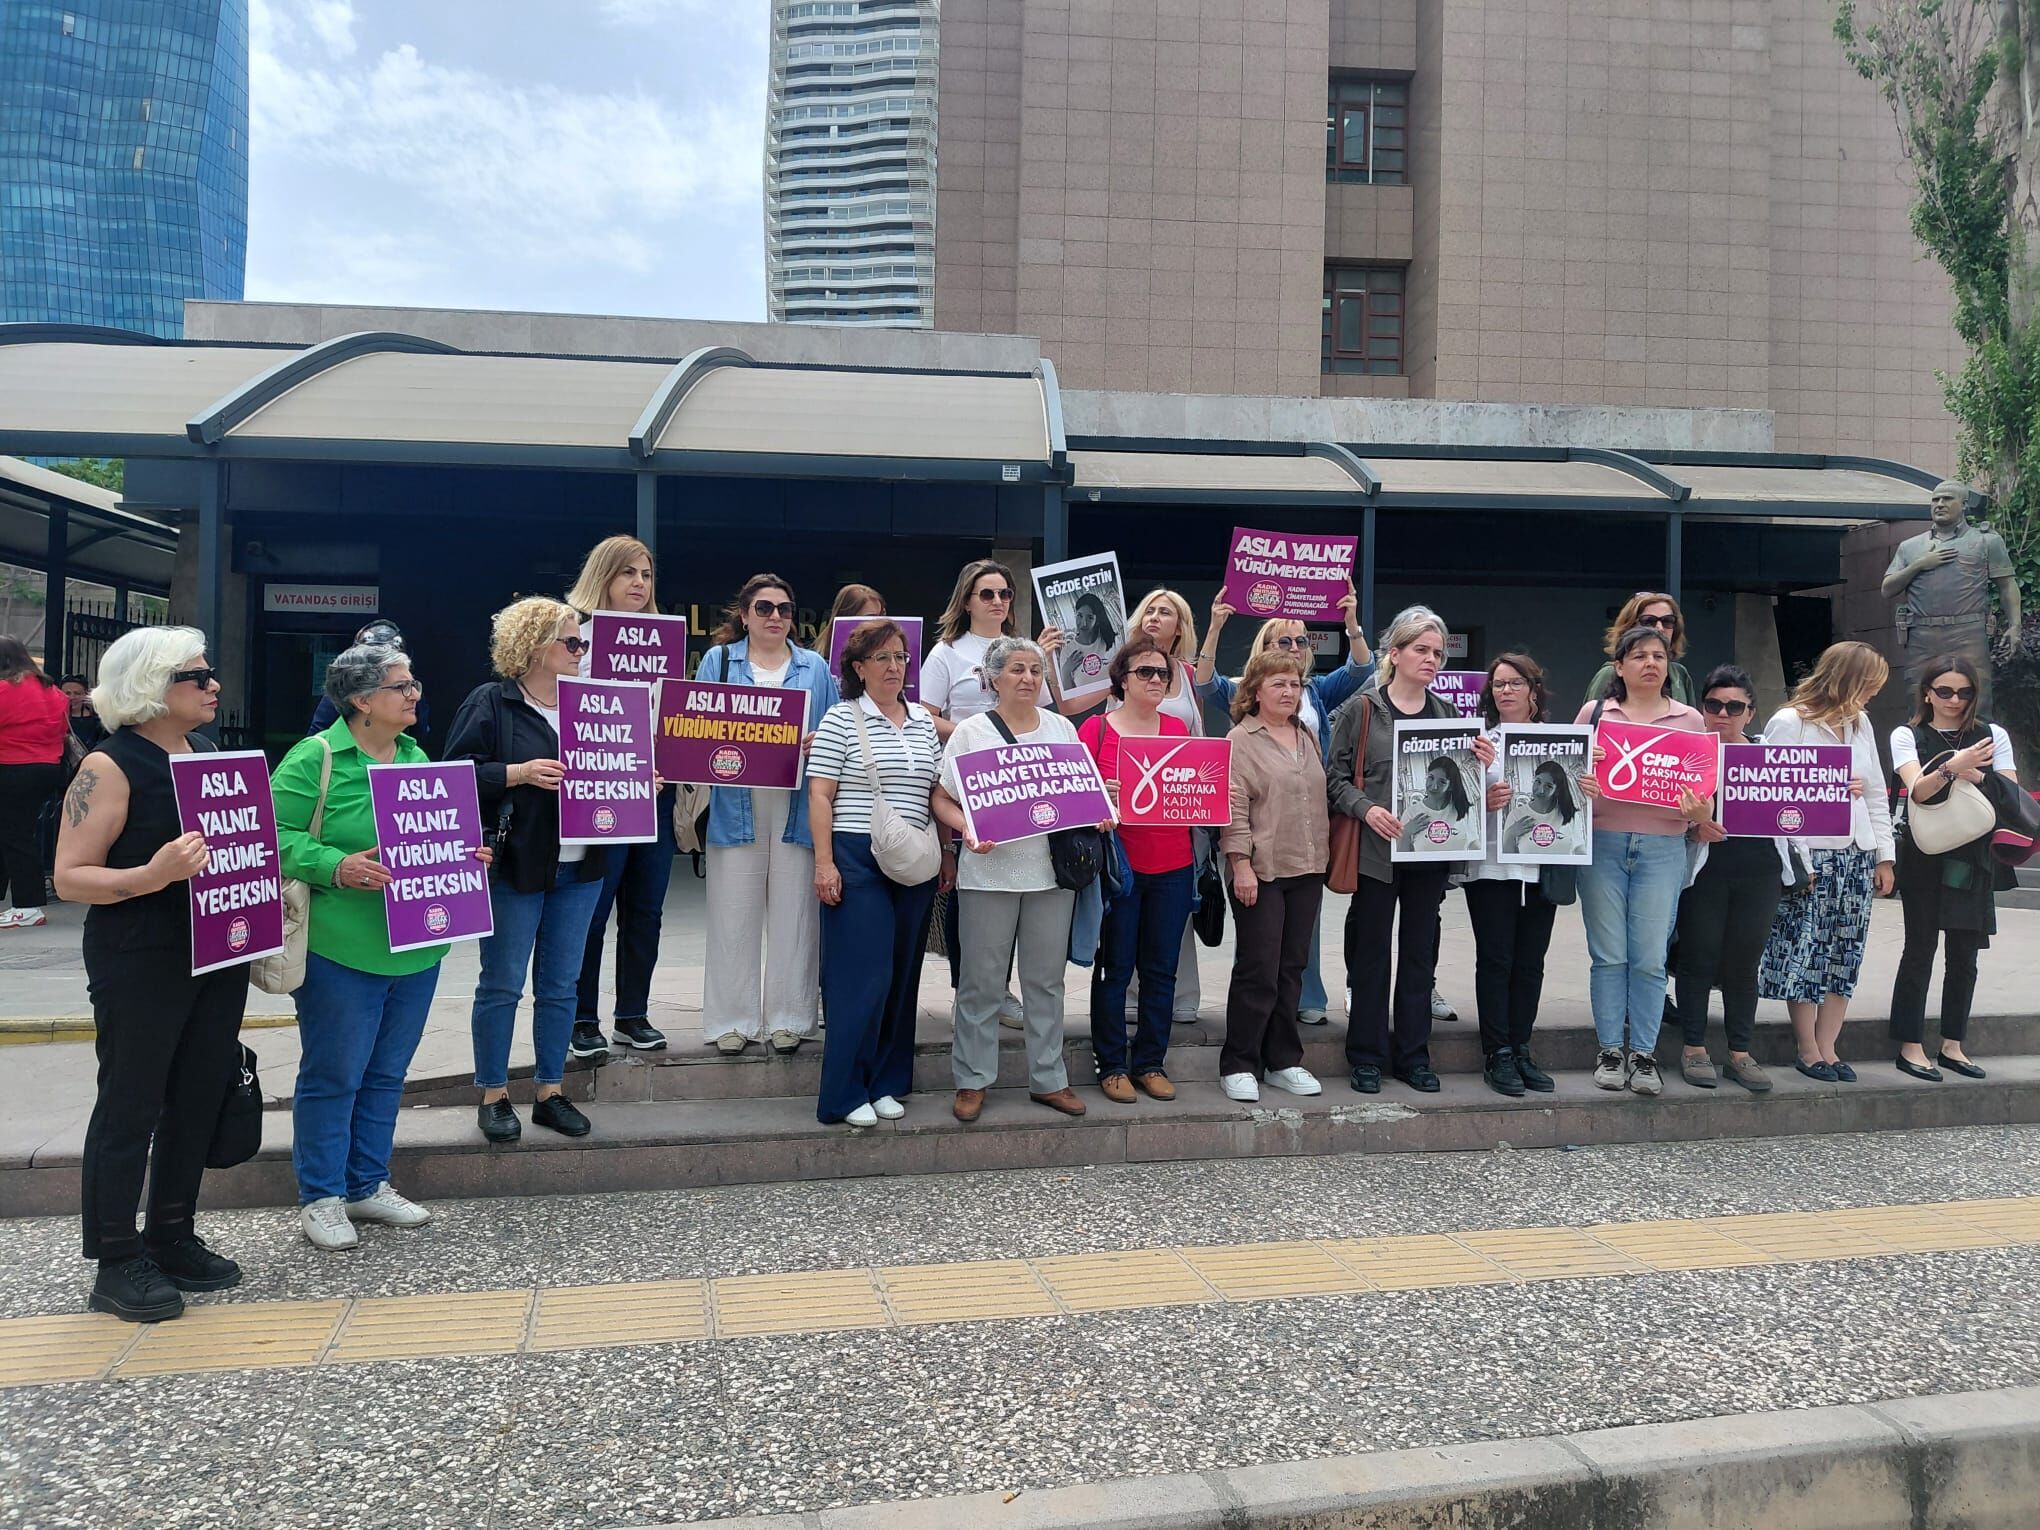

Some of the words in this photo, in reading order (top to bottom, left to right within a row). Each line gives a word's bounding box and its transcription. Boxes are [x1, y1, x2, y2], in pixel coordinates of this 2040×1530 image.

[1235, 535, 1287, 560] ASLA
[1291, 542, 1353, 563] YALNIZ
[1234, 557, 1350, 581] YÜRÜMEYECEKSİN
[1045, 578, 1081, 598] GÖZDE
[1081, 568, 1113, 592] ÇETİN
[274, 594, 337, 607] VATANDAŞ
[341, 593, 377, 608] GİRİŞİ
[1283, 607, 1317, 616] PLATFORMU
[615, 626, 662, 647] ASLA
[608, 653, 668, 674] YALNIZ
[1428, 675, 1463, 691] ADIN
[579, 693, 624, 715] ASLA
[685, 690, 725, 713] ASLA
[731, 693, 782, 717] YALNIZ
[573, 722, 633, 743] YALNIZ
[663, 713, 798, 745] YÜRÜMEYECEKSİN
[1402, 736, 1440, 754] GÖZDE
[1509, 740, 1547, 757] GÖZDE
[1548, 739, 1584, 758] ÇETİN
[564, 748, 647, 772] YÜRÜME-
[996, 746, 1053, 766] KADIN
[1641, 752, 1681, 767] CHP
[1765, 748, 1817, 765] KADIN
[965, 758, 1092, 791] CİNAYETLERİNİ
[1161, 767, 1196, 783] CHP
[1642, 766, 1703, 783] KARŞIYAKA
[1727, 764, 1849, 784] CİNAYETLERİNİ
[201, 771, 248, 799] ASLA
[397, 778, 448, 801] ASLA
[563, 778, 650, 800] YECEKSİN
[967, 775, 1101, 811] DURDURACAĞIZ
[1163, 784, 1217, 796] KARŞIYAKA
[1641, 788, 1681, 803] KOLLA
[1725, 784, 1850, 803] DURDURACAĞIZ
[1163, 797, 1202, 807] KADIN
[197, 806, 260, 837] YALNIZ
[393, 808, 460, 834] YALNIZ
[1163, 808, 1211, 820] KOLLARI
[198, 842, 274, 878] ÜRÜME-
[385, 839, 476, 869] YÜRÜME-
[389, 869, 483, 901] YECEKSİN
[195, 876, 278, 916] YECEKSİN
